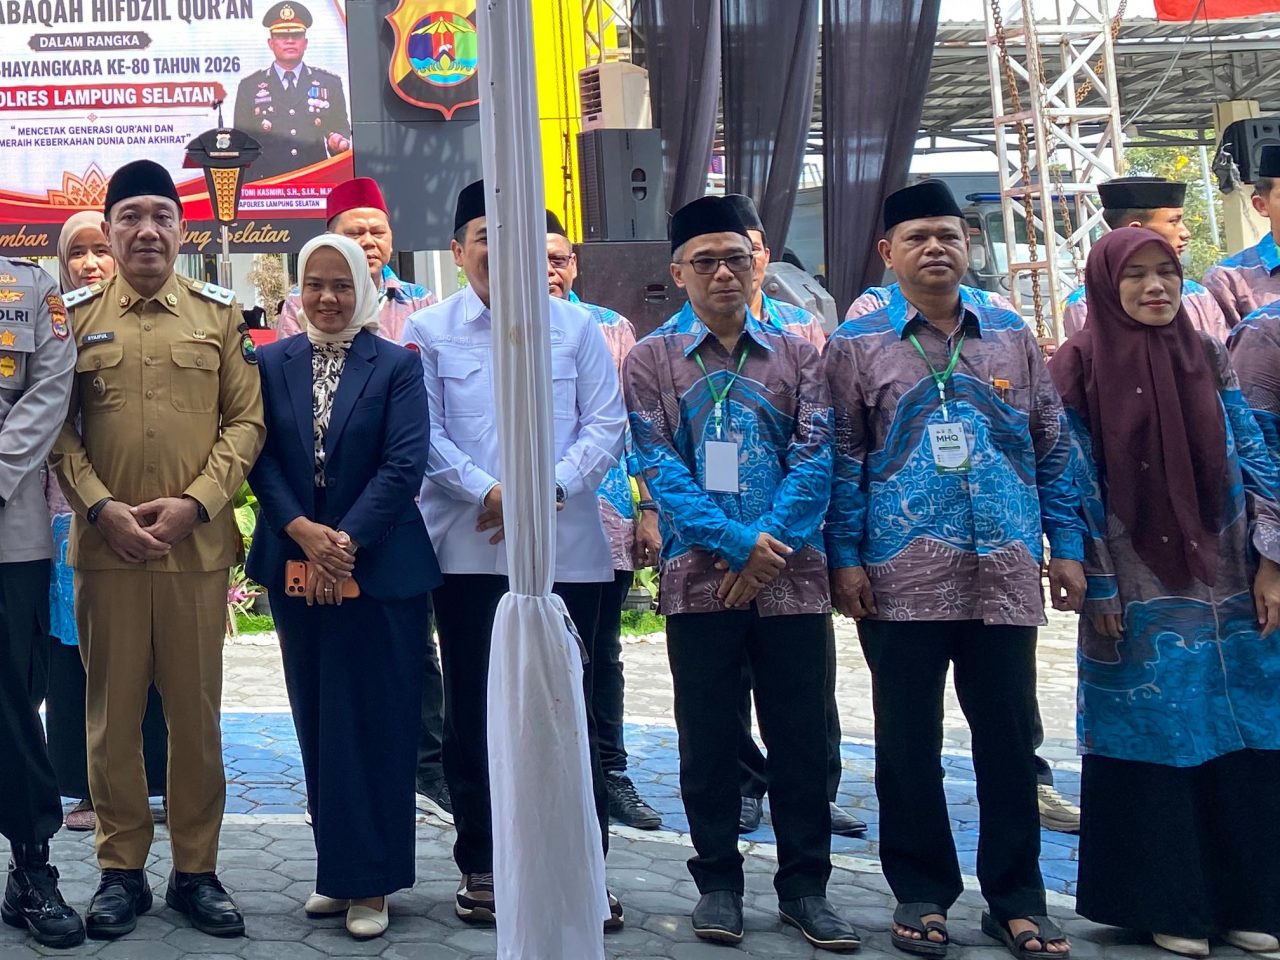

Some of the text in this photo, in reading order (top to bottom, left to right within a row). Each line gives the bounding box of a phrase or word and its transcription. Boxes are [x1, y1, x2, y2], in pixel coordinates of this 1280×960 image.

[39, 34, 140, 48] DALAM RANGKA
[107, 58, 150, 75] KE-80
[153, 57, 200, 74] TAHUN
[204, 56, 241, 73] 2026
[53, 88, 137, 106] LAMPUNG
[141, 86, 215, 104] SELATAN
[17, 126, 66, 136] MENCETAK
[68, 125, 113, 135] GENERASI
[115, 124, 152, 135] QUR'ANI
[154, 124, 174, 133] DAN
[34, 137, 95, 147] KEBERKAHAN
[96, 136, 125, 146] DUNIA
[127, 136, 146, 145] DAN
[241, 188, 256, 196] TONI
[238, 199, 320, 208] APOLRES LAMPUNG SELATAN
[936, 434, 959, 442] MHQ
